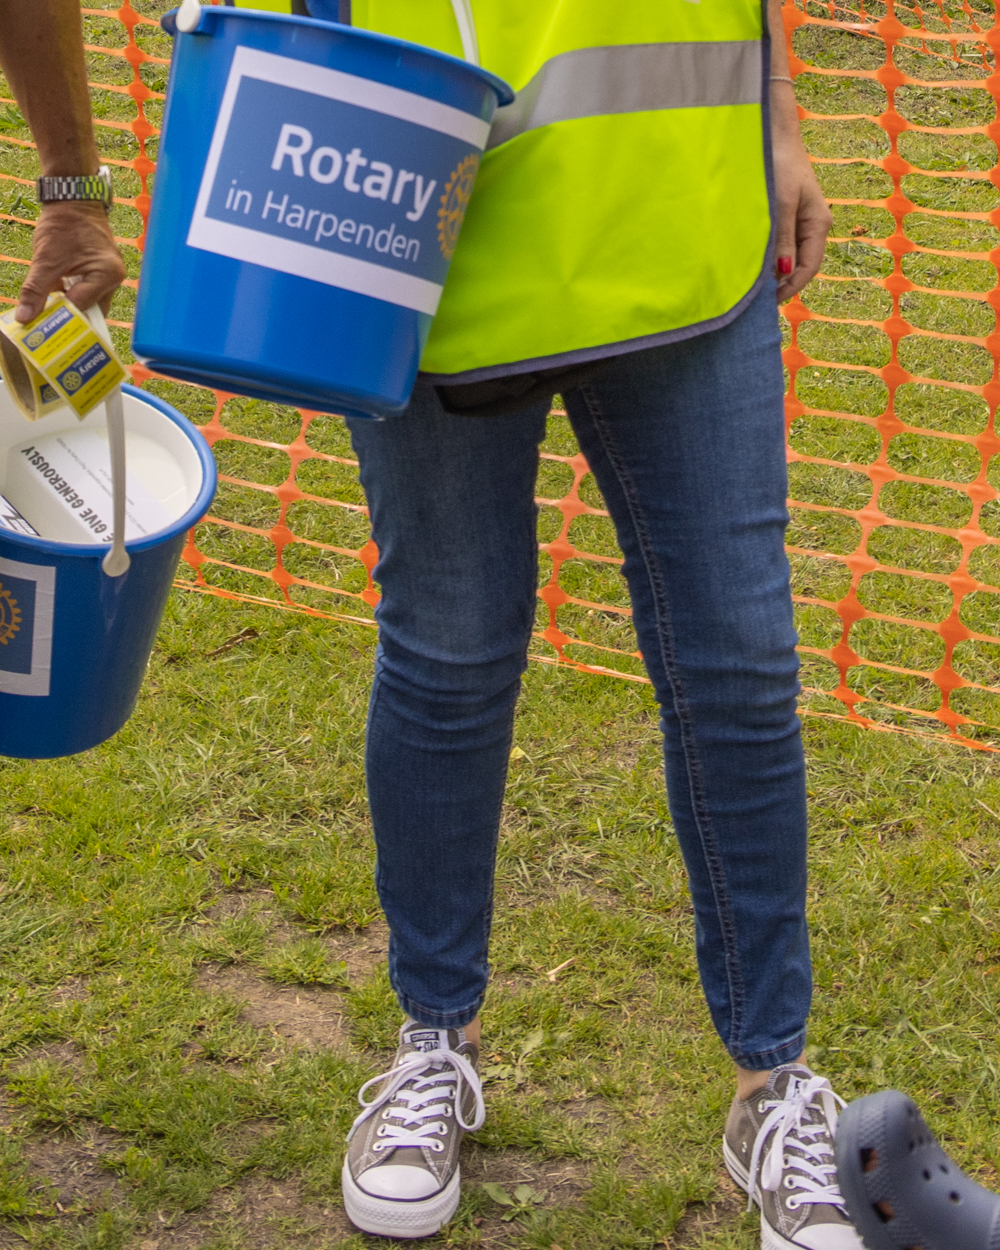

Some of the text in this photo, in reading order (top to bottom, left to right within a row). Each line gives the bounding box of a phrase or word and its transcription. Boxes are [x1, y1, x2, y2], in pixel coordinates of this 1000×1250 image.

[271, 123, 437, 222] Rotary
[224, 179, 421, 262] in Harpenden
[43, 310, 70, 334] Rotary
[79, 351, 107, 376] Rotary
[21, 445, 84, 509] GENEROUSLY
[79, 508, 108, 535] GIVE
